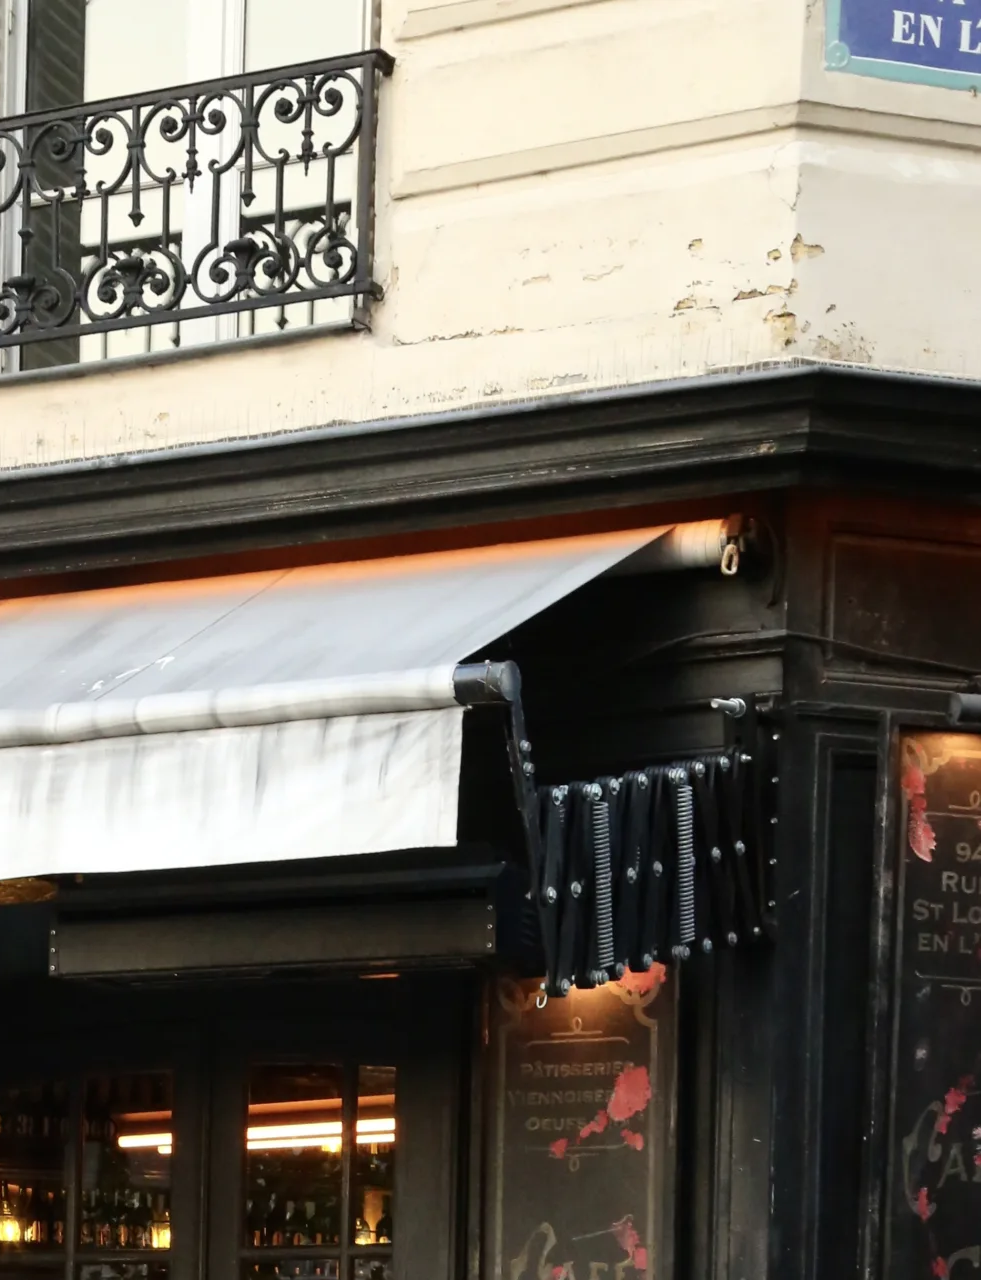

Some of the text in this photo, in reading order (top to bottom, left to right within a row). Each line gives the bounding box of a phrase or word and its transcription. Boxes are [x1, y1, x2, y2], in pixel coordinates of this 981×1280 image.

[892, 10, 943, 48] EN
[917, 933, 950, 953] EN
[902, 1100, 981, 1218] CA
